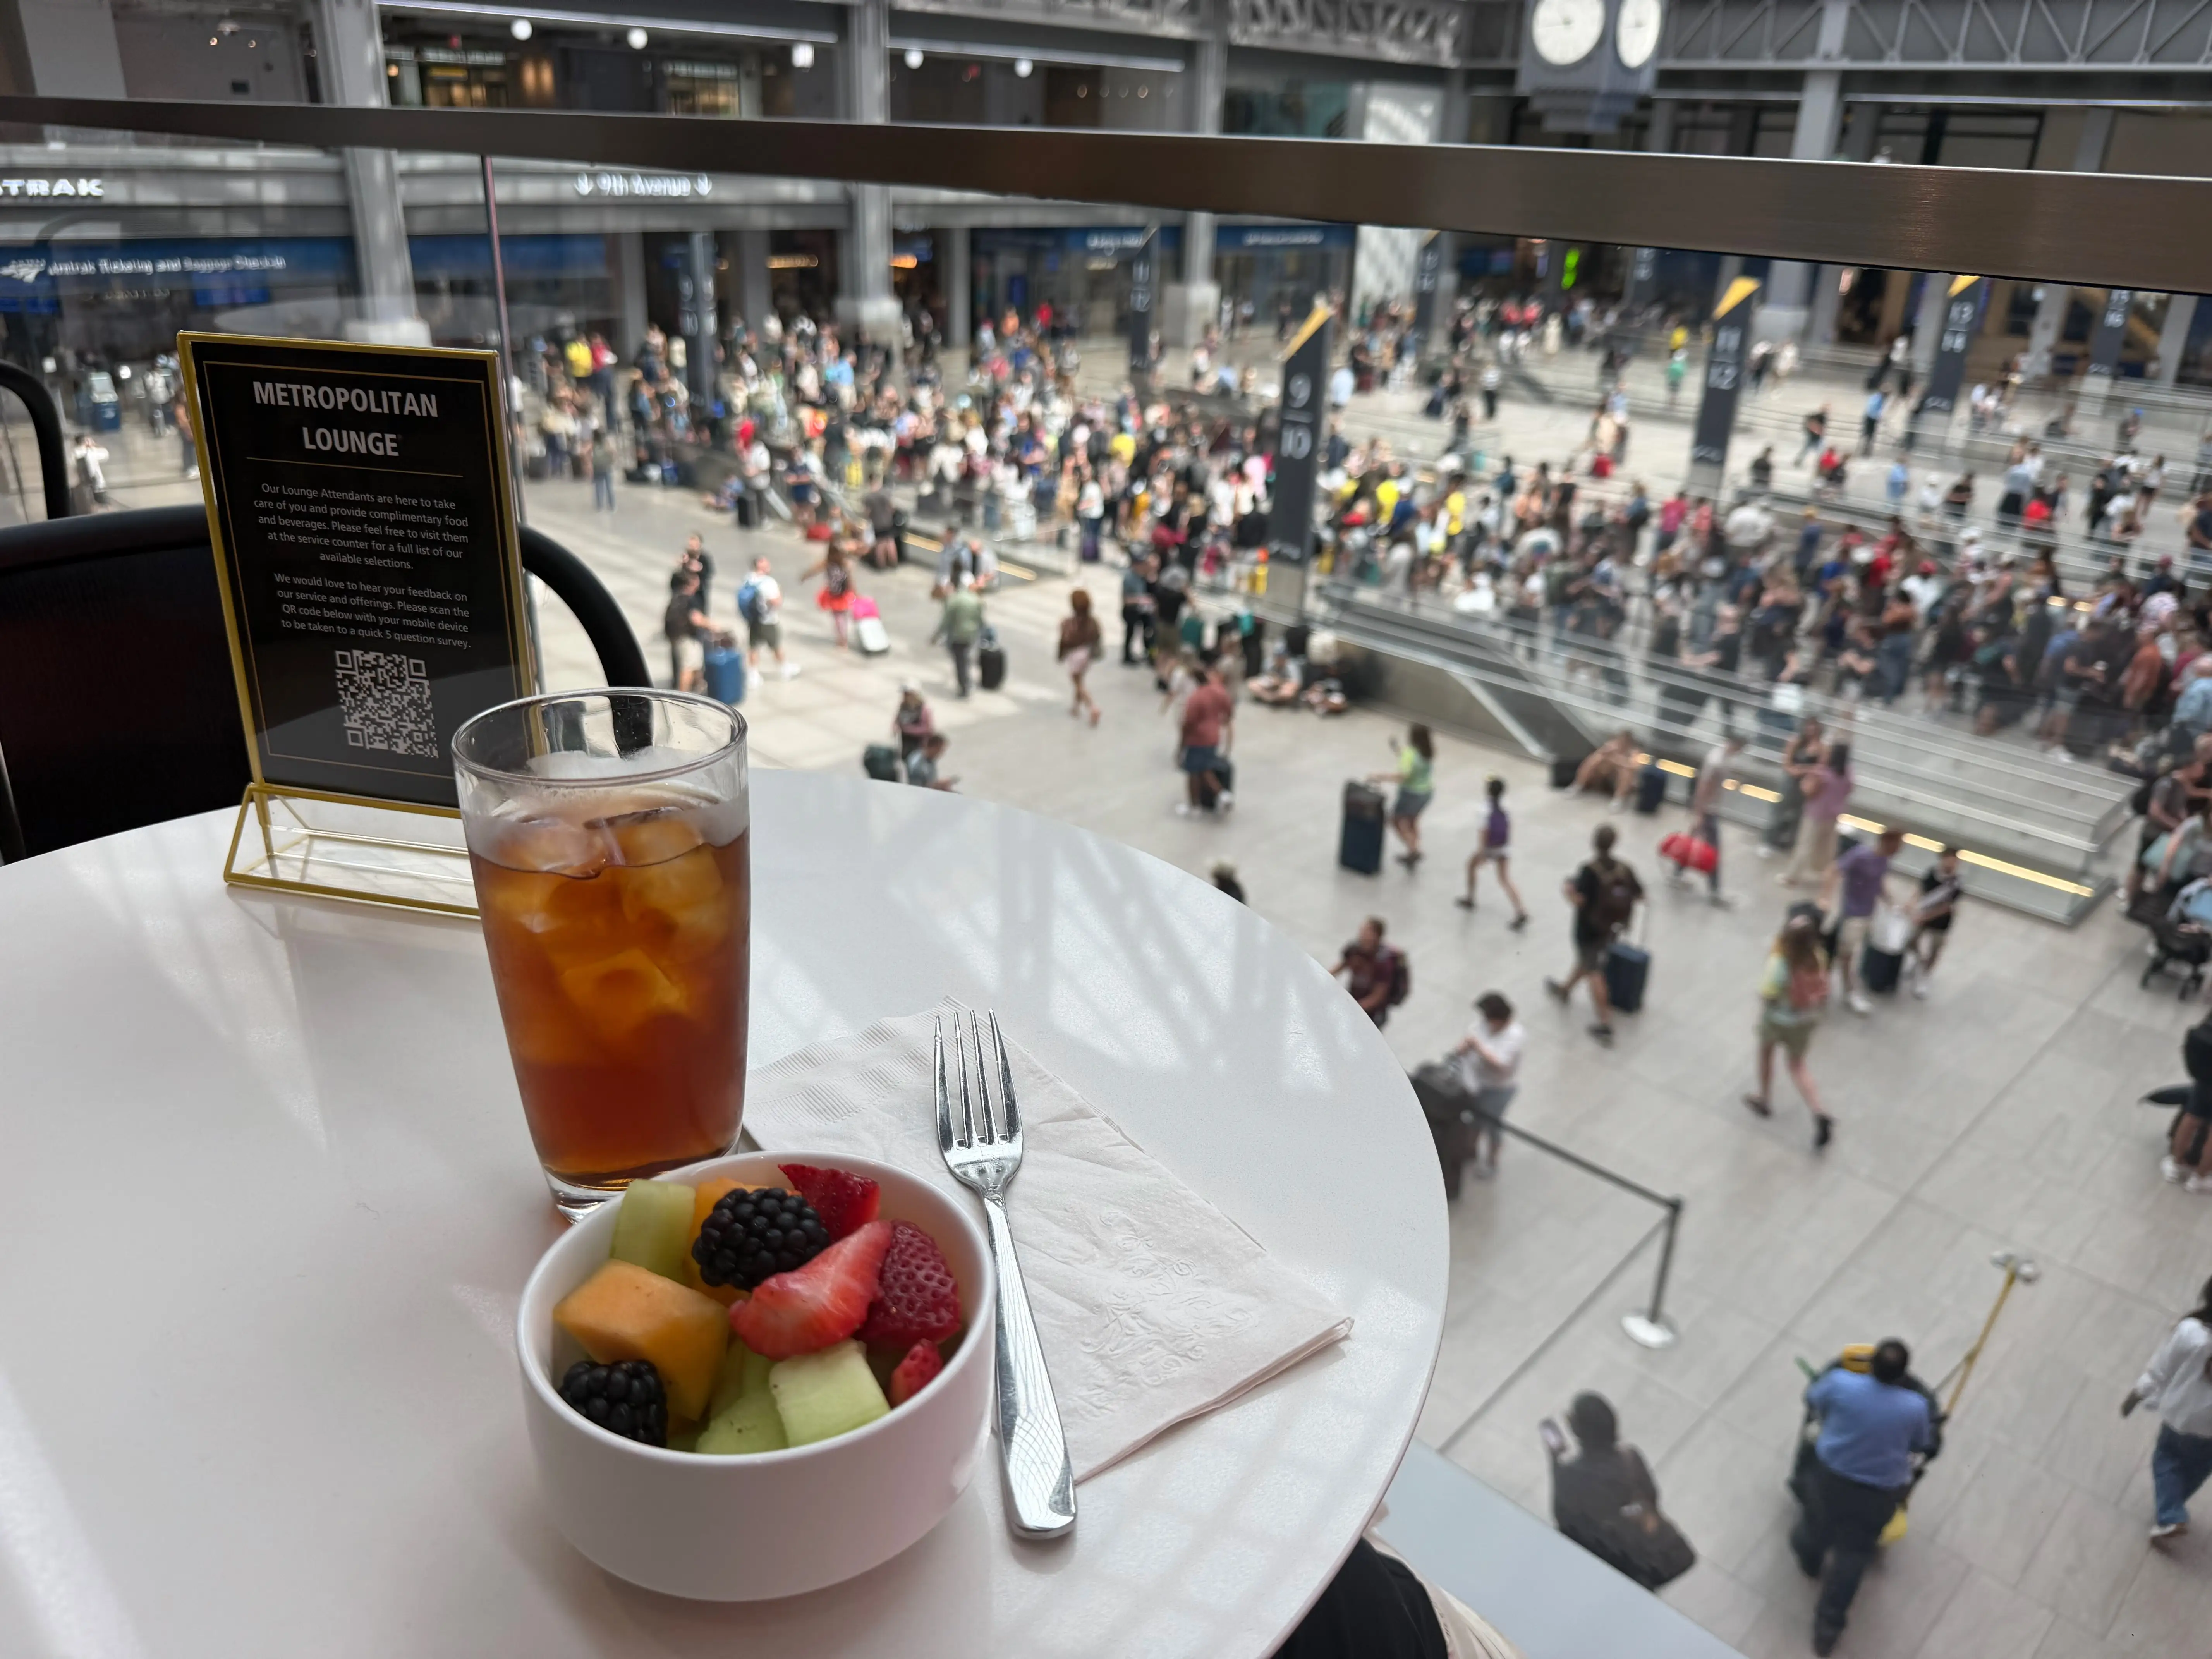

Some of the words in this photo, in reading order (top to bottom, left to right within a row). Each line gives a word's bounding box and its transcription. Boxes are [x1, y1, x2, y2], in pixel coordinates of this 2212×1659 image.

[0, 179, 104, 196] TRAK
[597, 173, 628, 196] 9th
[630, 173, 690, 196] Avenue
[253, 381, 438, 417] METROPOLITAN
[1289, 373, 1312, 408] 9
[302, 426, 399, 456] LOUNGE
[1280, 425, 1312, 459] 10
[262, 483, 280, 493] Our
[282, 485, 318, 498] Lounge
[321, 489, 374, 502] Attendants
[395, 495, 417, 506] here
[420, 498, 431, 507] to
[433, 499, 455, 509] take
[254, 500, 273, 508] care
[276, 500, 286, 510] of
[289, 504, 307, 513] you
[309, 504, 327, 514] and
[330, 507, 366, 517] provide
[369, 511, 442, 526] complimentary
[445, 515, 468, 527] food
[259, 515, 276, 524] and
[278, 516, 329, 531] beverages.
[331, 521, 361, 532] Please
[364, 524, 382, 534] feel
[385, 526, 405, 537] free
[407, 529, 418, 538] to
[420, 530, 440, 540] visit
[442, 532, 468, 543] them
[268, 532, 278, 540] at
[279, 532, 295, 542] the
[298, 535, 330, 545] service
[332, 539, 369, 549] counter
[371, 541, 386, 550] for
[397, 543, 413, 553] full
[416, 544, 430, 555] list
[433, 547, 443, 556] of
[446, 550, 463, 558] our
[320, 553, 362, 564] available
[364, 556, 413, 569] selections.
[274, 573, 290, 583] We
[293, 577, 322, 586] would
[325, 578, 344, 589] love
[346, 582, 357, 590] to
[359, 582, 381, 592] hear
[383, 587, 405, 595] your
[408, 587, 452, 600] feedback
[282, 604, 297, 614] QR
[299, 607, 321, 616] code
[323, 608, 352, 619] below
[355, 612, 376, 622] with
[378, 617, 400, 625] your
[402, 618, 435, 629] mobile
[438, 621, 468, 632] device
[296, 592, 327, 602] service
[330, 595, 347, 604] and
[350, 596, 395, 610] offerings.
[397, 601, 427, 612] Please
[429, 607, 450, 615] scan
[452, 607, 469, 617] the
[281, 620, 292, 628] to
[294, 620, 306, 629] be
[307, 622, 335, 632] taken
[358, 628, 383, 638] quick
[386, 630, 392, 639] 5
[394, 633, 435, 643] question
[437, 638, 471, 649] survey.
